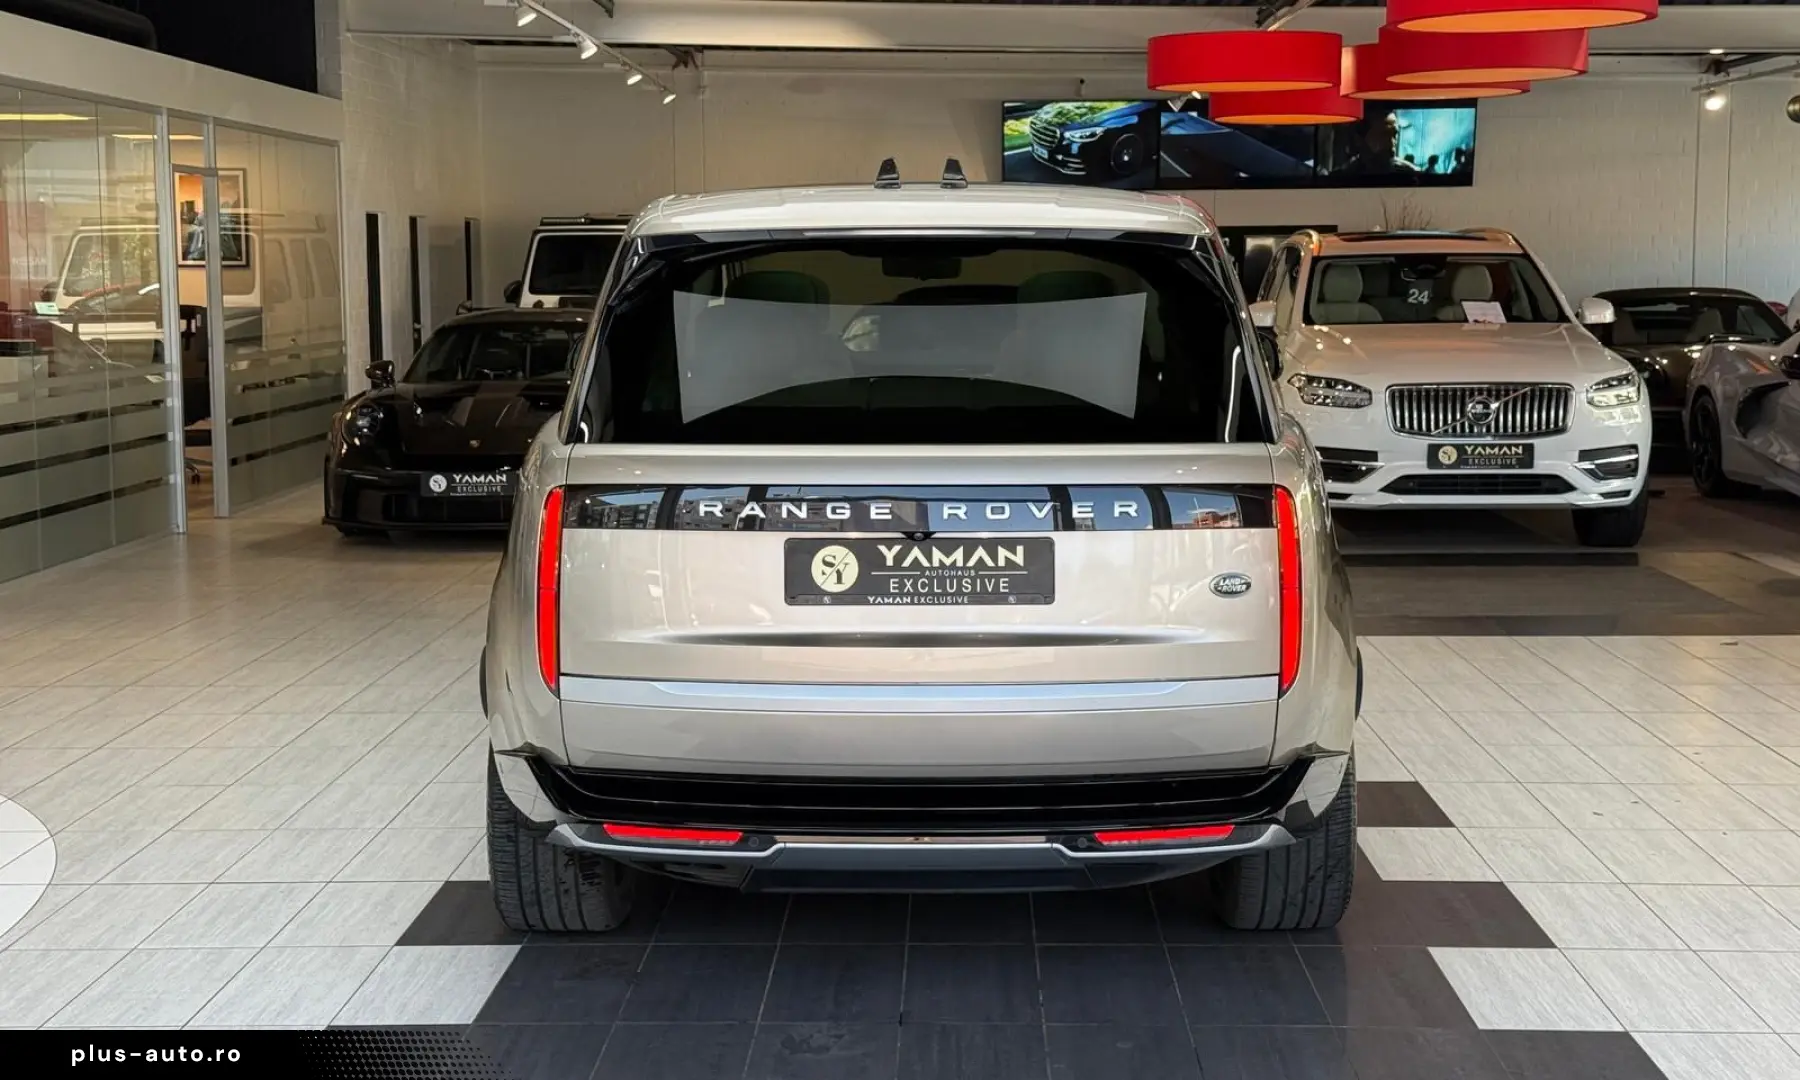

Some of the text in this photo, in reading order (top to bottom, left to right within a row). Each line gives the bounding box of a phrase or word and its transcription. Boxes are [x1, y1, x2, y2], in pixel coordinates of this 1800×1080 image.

[1407, 288, 1430, 305] 24
[1465, 445, 1523, 455] YAMAN
[453, 474, 507, 483] YAMAN
[699, 501, 1139, 520] RANGE ROVER
[877, 545, 1024, 568] YAMAN
[925, 569, 976, 577] AUTOHAUS
[889, 578, 1009, 593] EXCLUSIVE
[867, 596, 969, 604] YAMAN EXCLUSIVE
